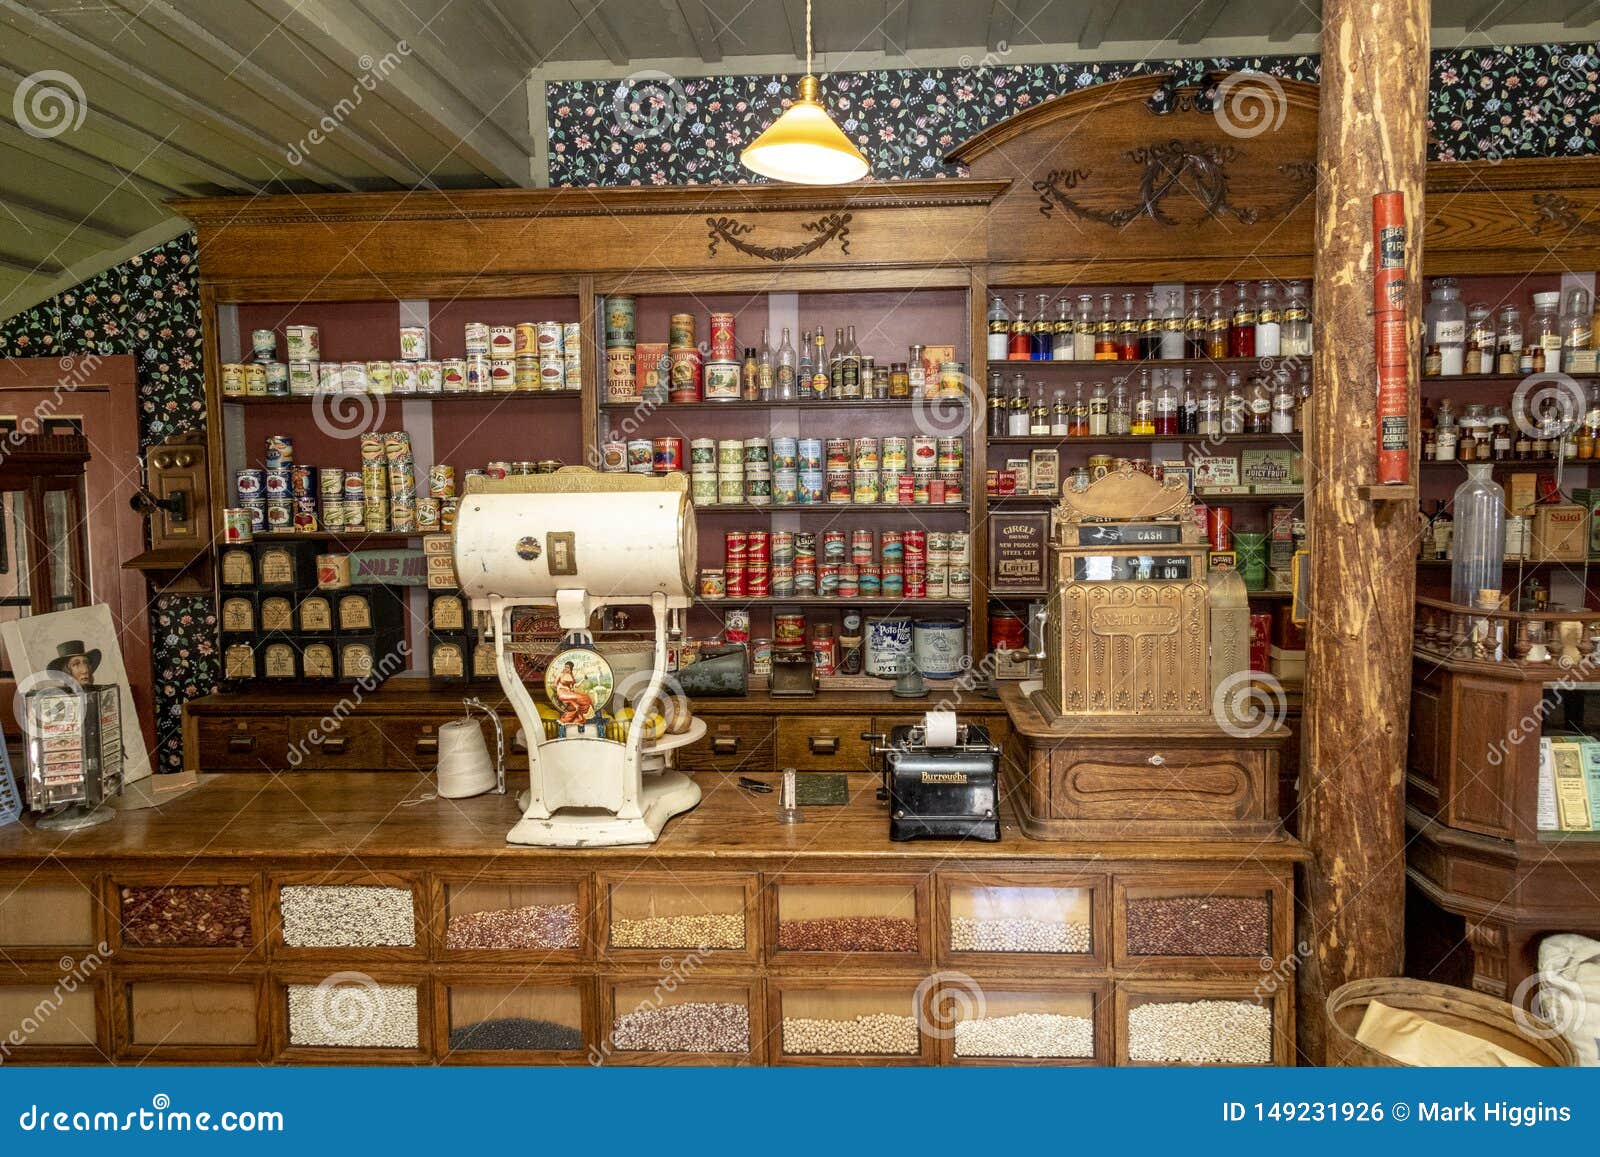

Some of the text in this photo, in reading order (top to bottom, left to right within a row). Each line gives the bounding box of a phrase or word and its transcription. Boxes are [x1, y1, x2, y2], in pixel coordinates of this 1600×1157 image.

[1246, 469, 1266, 478] JUICY
[1267, 469, 1287, 478] FRUIT
[1138, 532, 1162, 543] CASH
[357, 557, 399, 577] MILE
[921, 771, 968, 783] Burroughs
